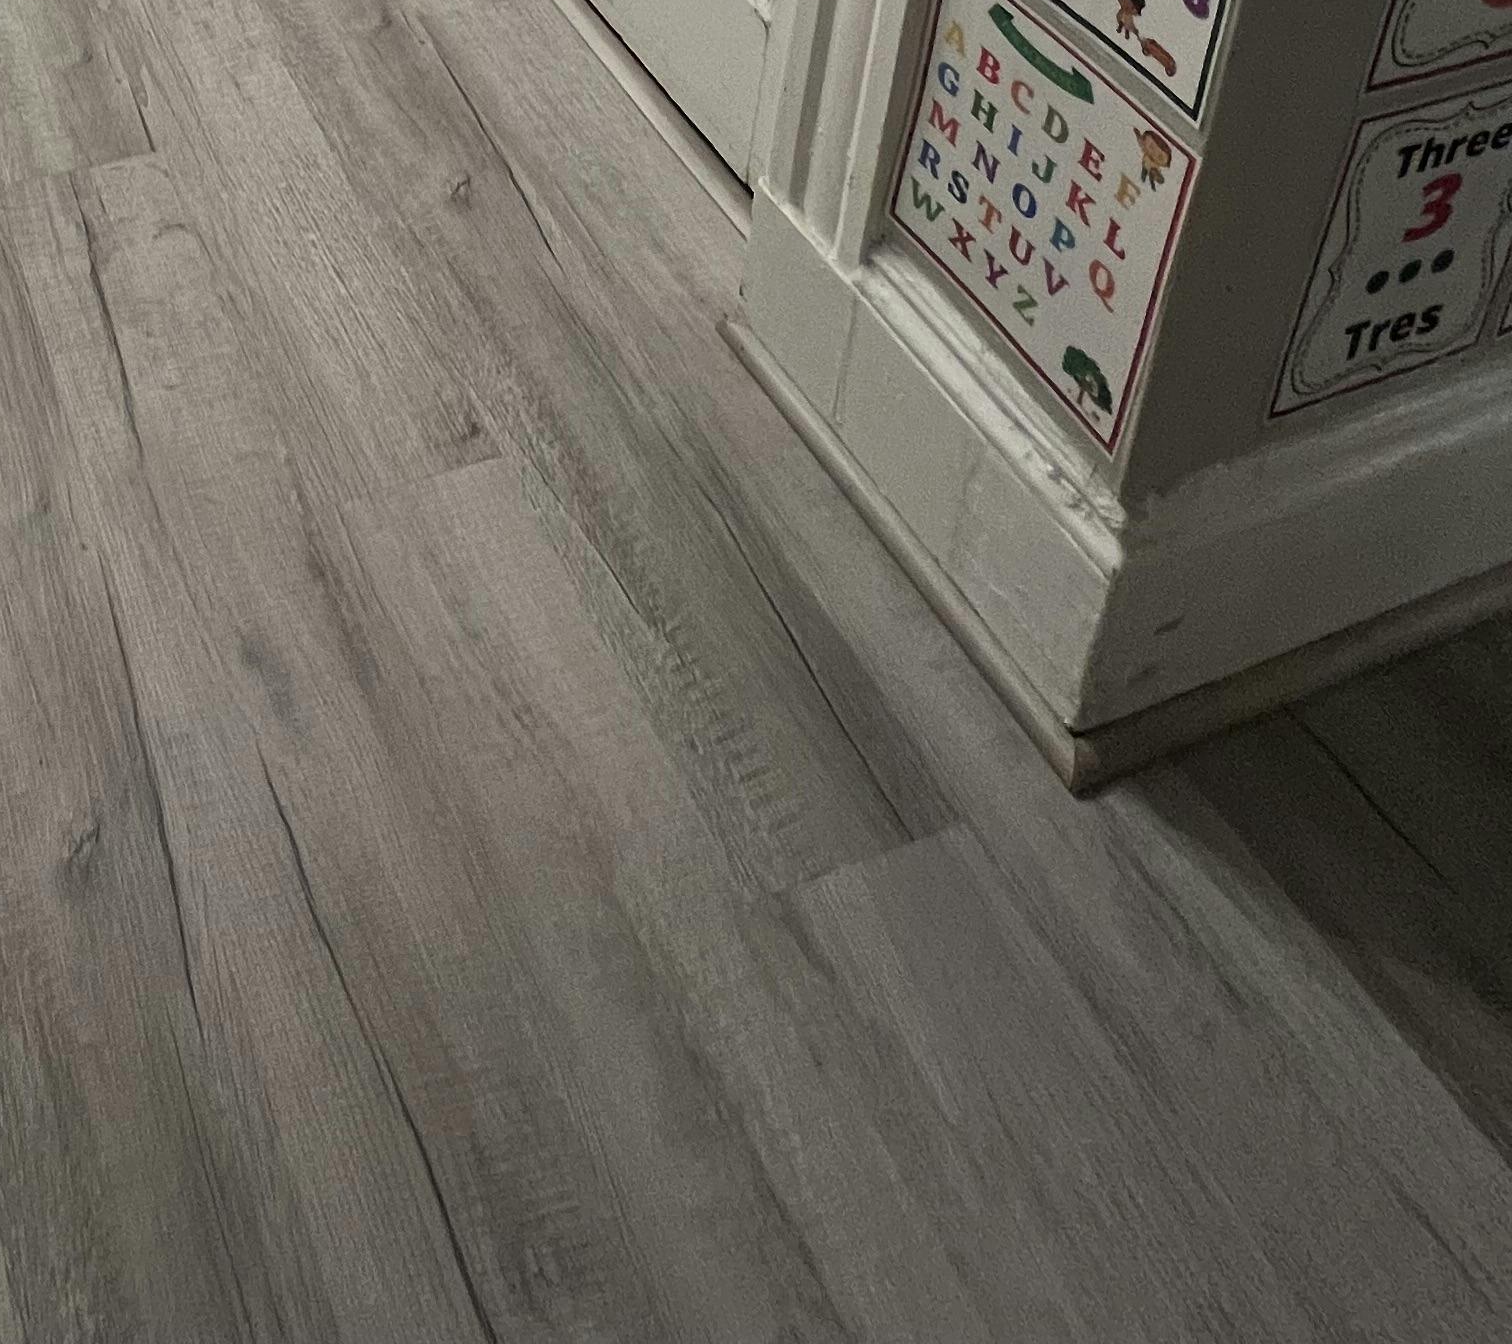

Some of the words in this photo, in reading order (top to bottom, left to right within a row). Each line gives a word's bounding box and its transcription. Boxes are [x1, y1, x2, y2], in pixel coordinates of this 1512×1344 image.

[938, 62, 960, 98] G
[971, 89, 999, 134] H
[1007, 123, 1023, 157] I
[1031, 154, 1058, 184] J
[1065, 179, 1096, 228] K
[1103, 216, 1126, 261] L
[944, 20, 966, 58] A
[976, 45, 1001, 85] B
[1011, 79, 1035, 116] C
[1041, 103, 1070, 144] D
[1077, 137, 1106, 182] E
[1397, 122, 1512, 179] Three
[910, 175, 946, 223] W
[948, 217, 977, 263] X
[983, 248, 1009, 290] Y
[1012, 284, 1039, 327] Z
[918, 139, 940, 180] R
[948, 170, 970, 204] S
[978, 194, 1002, 234] T
[1009, 224, 1036, 266] U
[1042, 256, 1070, 297] V
[929, 98, 961, 148] M
[971, 140, 1001, 185] N
[1012, 183, 1037, 219] O
[1049, 216, 1077, 253] P
[1089, 259, 1116, 314] Q
[1400, 172, 1463, 243] 3
[1345, 304, 1444, 361] Tres
